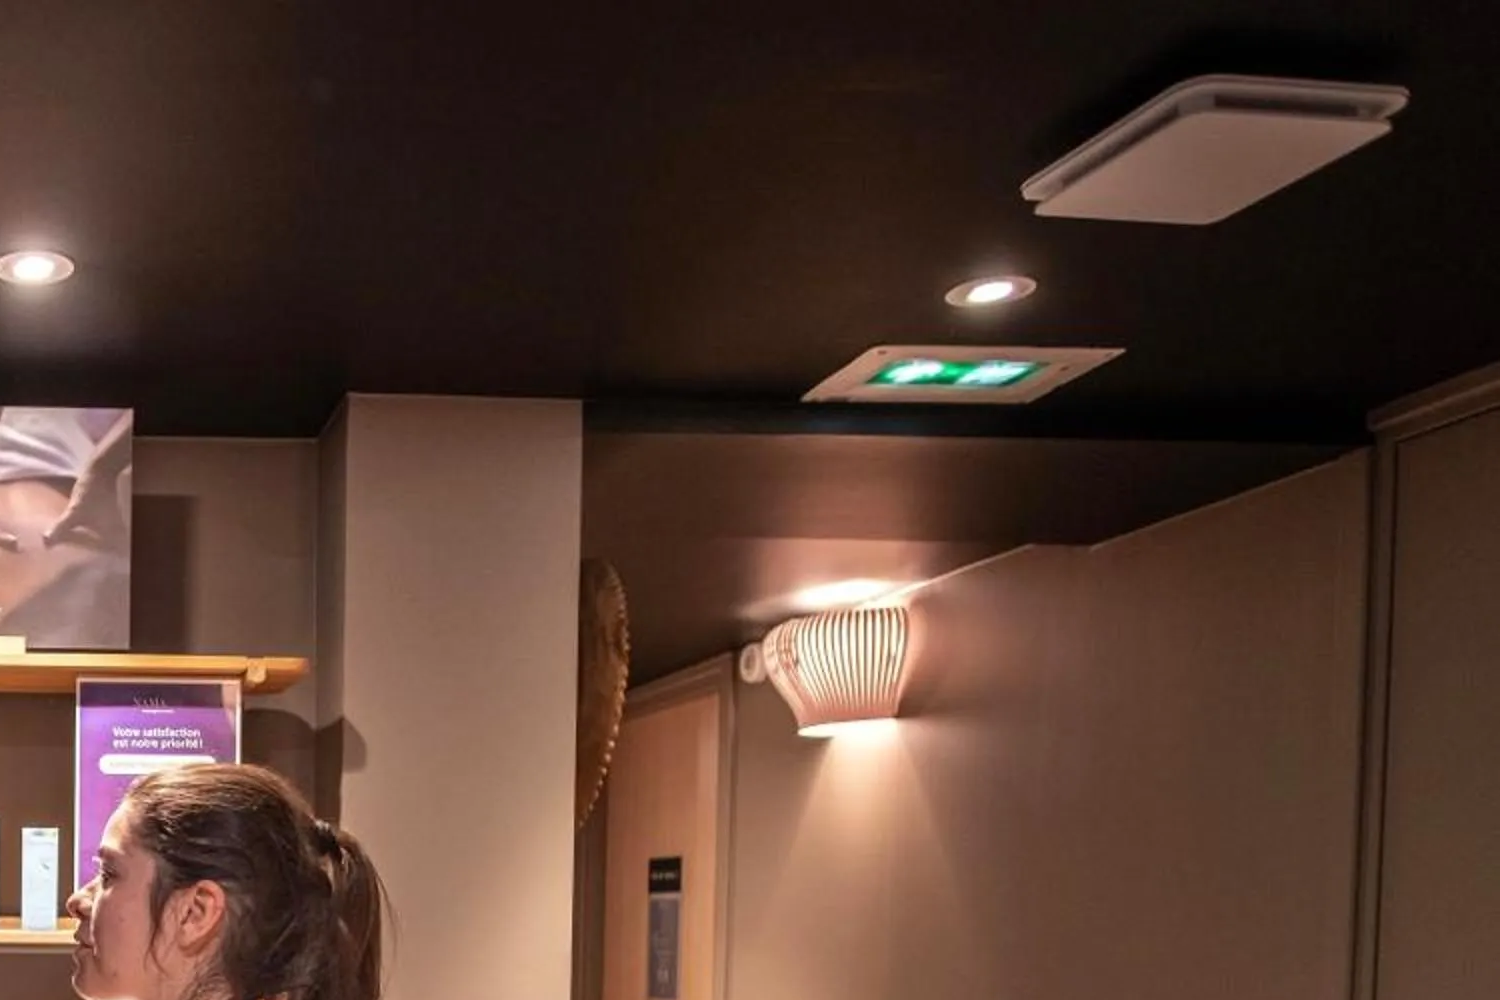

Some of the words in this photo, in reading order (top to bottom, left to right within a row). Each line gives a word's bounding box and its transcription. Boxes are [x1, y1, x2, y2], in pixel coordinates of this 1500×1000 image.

[112, 727, 140, 738] Votre
[143, 727, 201, 738] satisfaction
[112, 739, 128, 749] est
[131, 739, 158, 749] notre
